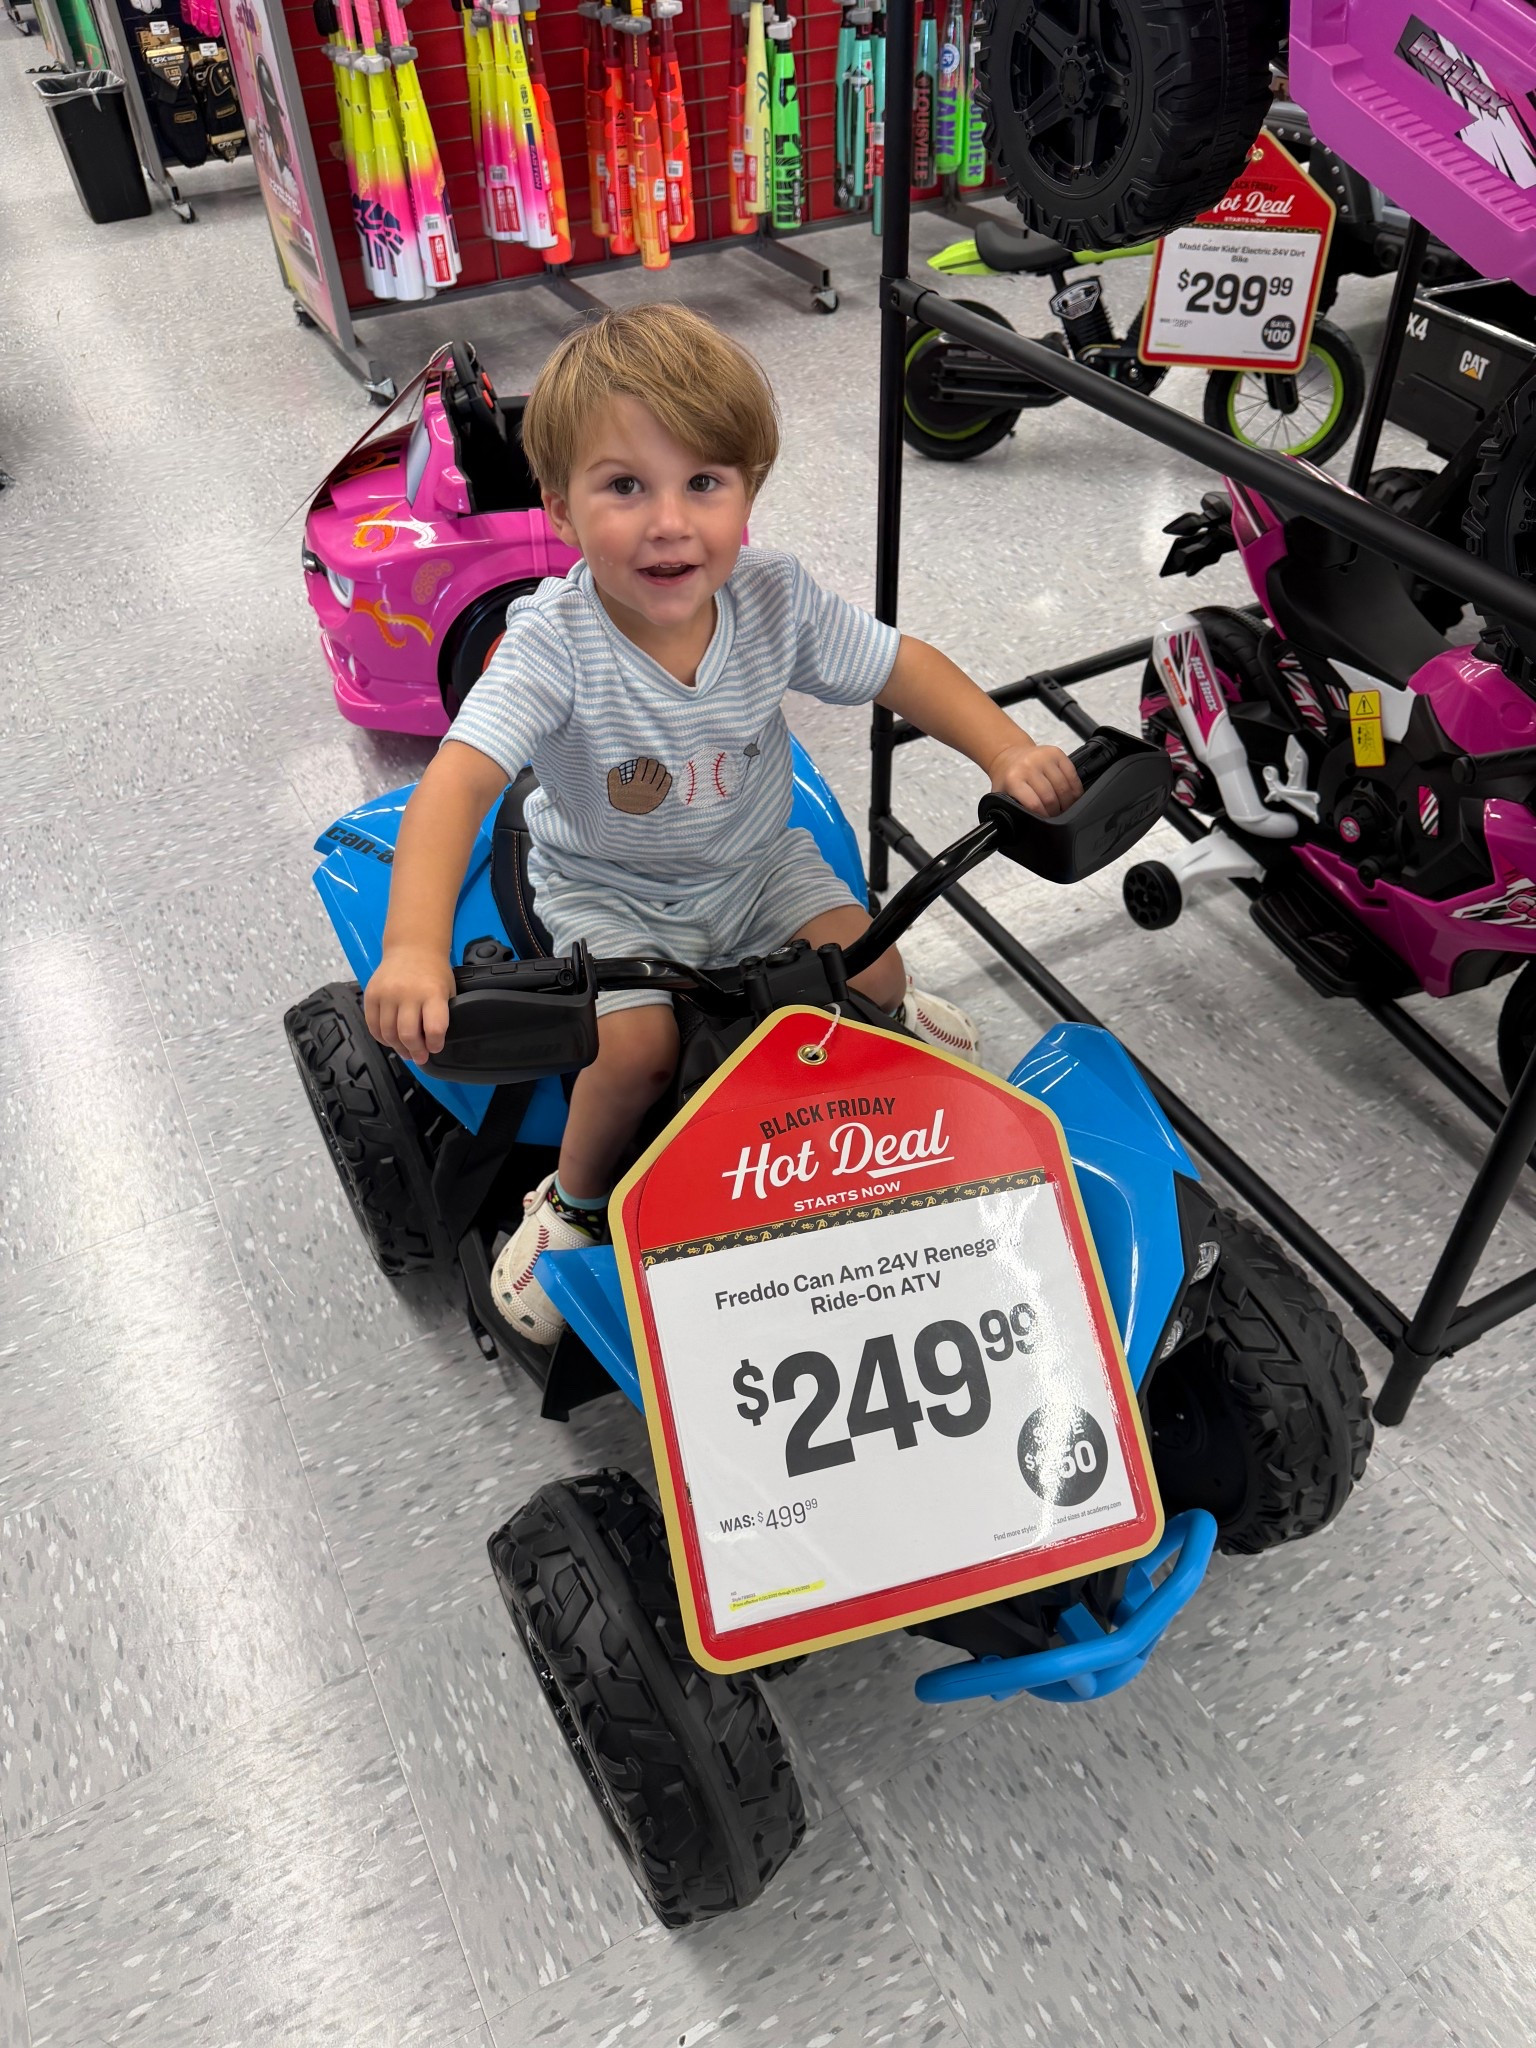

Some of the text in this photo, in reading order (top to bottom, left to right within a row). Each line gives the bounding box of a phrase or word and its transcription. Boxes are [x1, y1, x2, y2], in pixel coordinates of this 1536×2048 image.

[914, 88, 930, 180] LOUISVILLE
[936, 87, 957, 156] TANK
[969, 90, 984, 177] OLDIER
[529, 144, 542, 190] EASTON
[1243, 191, 1295, 214] Deal
[1231, 255, 1249, 263] Bike
[1241, 246, 1271, 256] Electric
[1272, 247, 1289, 257] 24V
[1289, 249, 1306, 258] Dirt
[1270, 320, 1291, 329] SAVE
[1459, 350, 1491, 381] CAT
[325, 827, 395, 864] can-a
[759, 1097, 896, 1140] BLACK FRIDAY
[722, 1108, 950, 1201] Hot Deal
[793, 1181, 901, 1212] STARTS NOW
[714, 1236, 1021, 1310] Freddo Can Am 24V Renega
[810, 1270, 941, 1315] Ride-On ATV
[1024, 1440, 1097, 1479] $50
[719, 1514, 756, 1533] WAS:
[993, 1533, 1007, 1541] Find
[1006, 1529, 1021, 1538] more
[1056, 1515, 1067, 1524] and
[1067, 1512, 1080, 1522] sizes
[1081, 1510, 1087, 1518] at
[1087, 1501, 1122, 1516] academy.com
